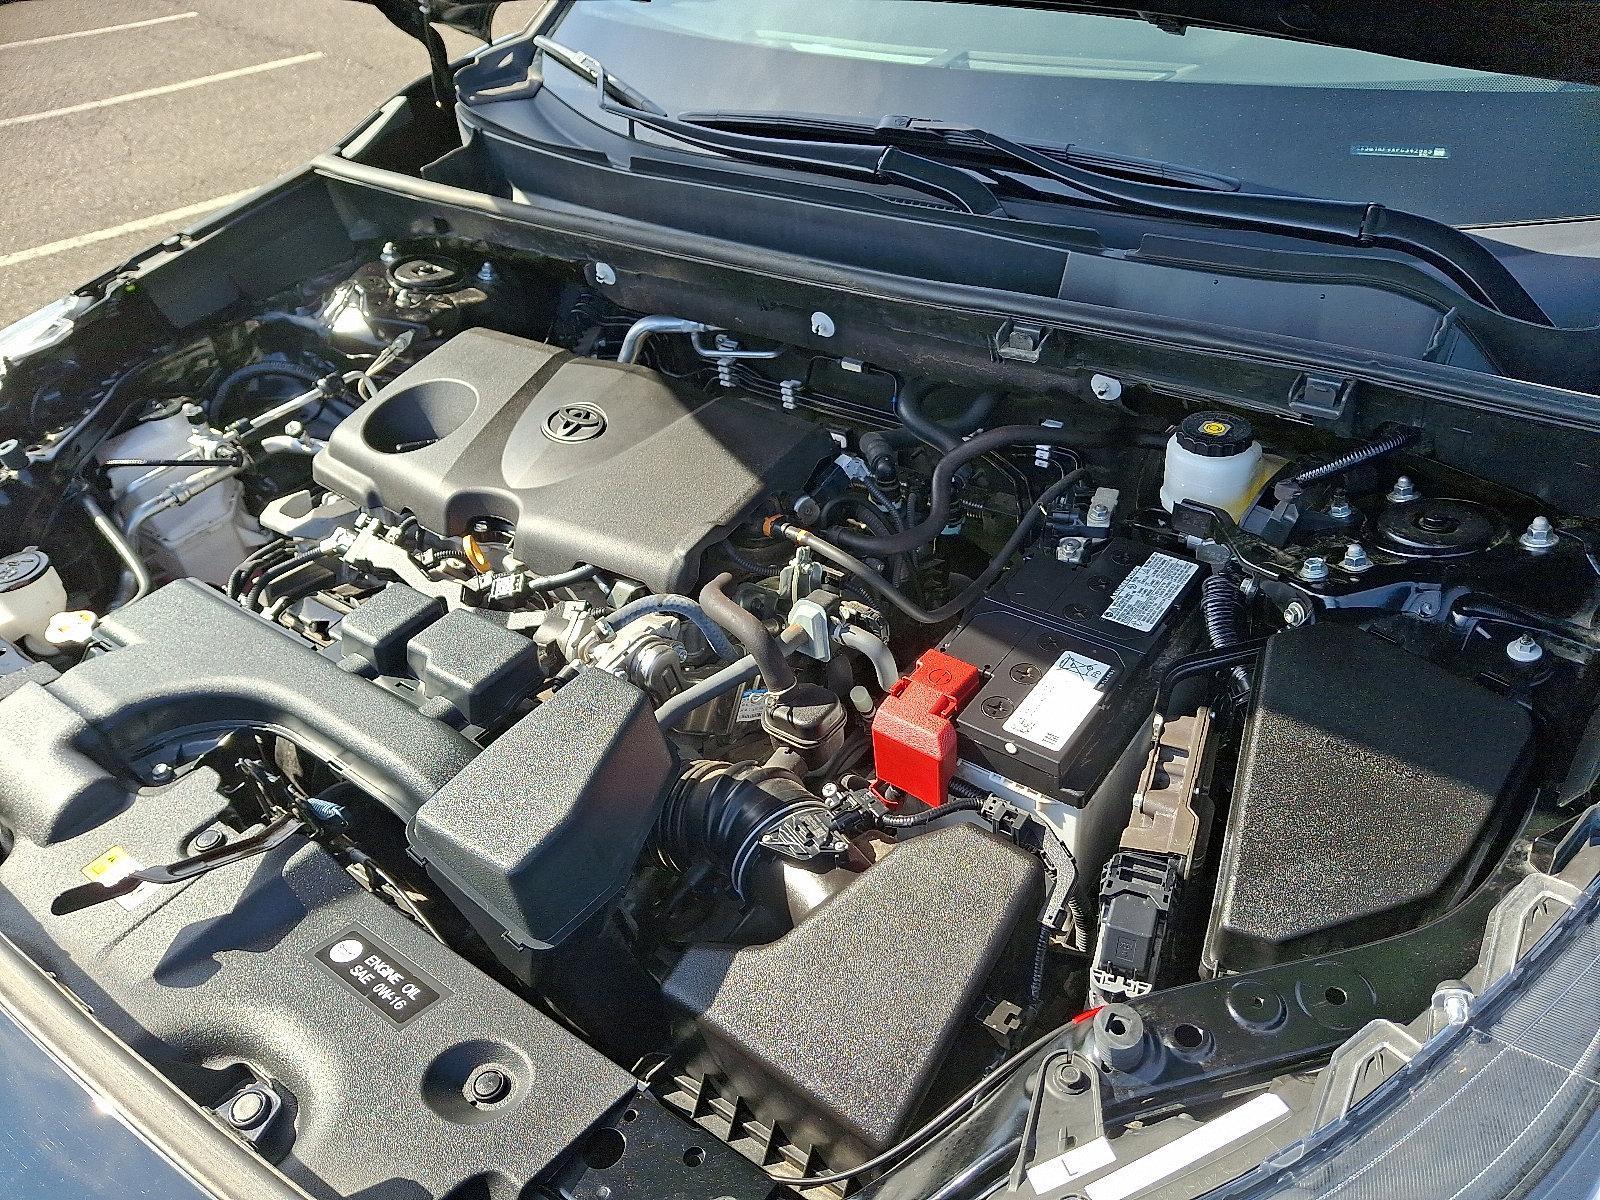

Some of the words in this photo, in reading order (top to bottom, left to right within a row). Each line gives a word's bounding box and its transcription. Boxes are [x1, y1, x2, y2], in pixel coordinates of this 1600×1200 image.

[350, 965, 375, 985] SAE
[372, 983, 407, 1010] 0W-16
[364, 955, 404, 984] ENGINE
[402, 983, 421, 1001] OIL
